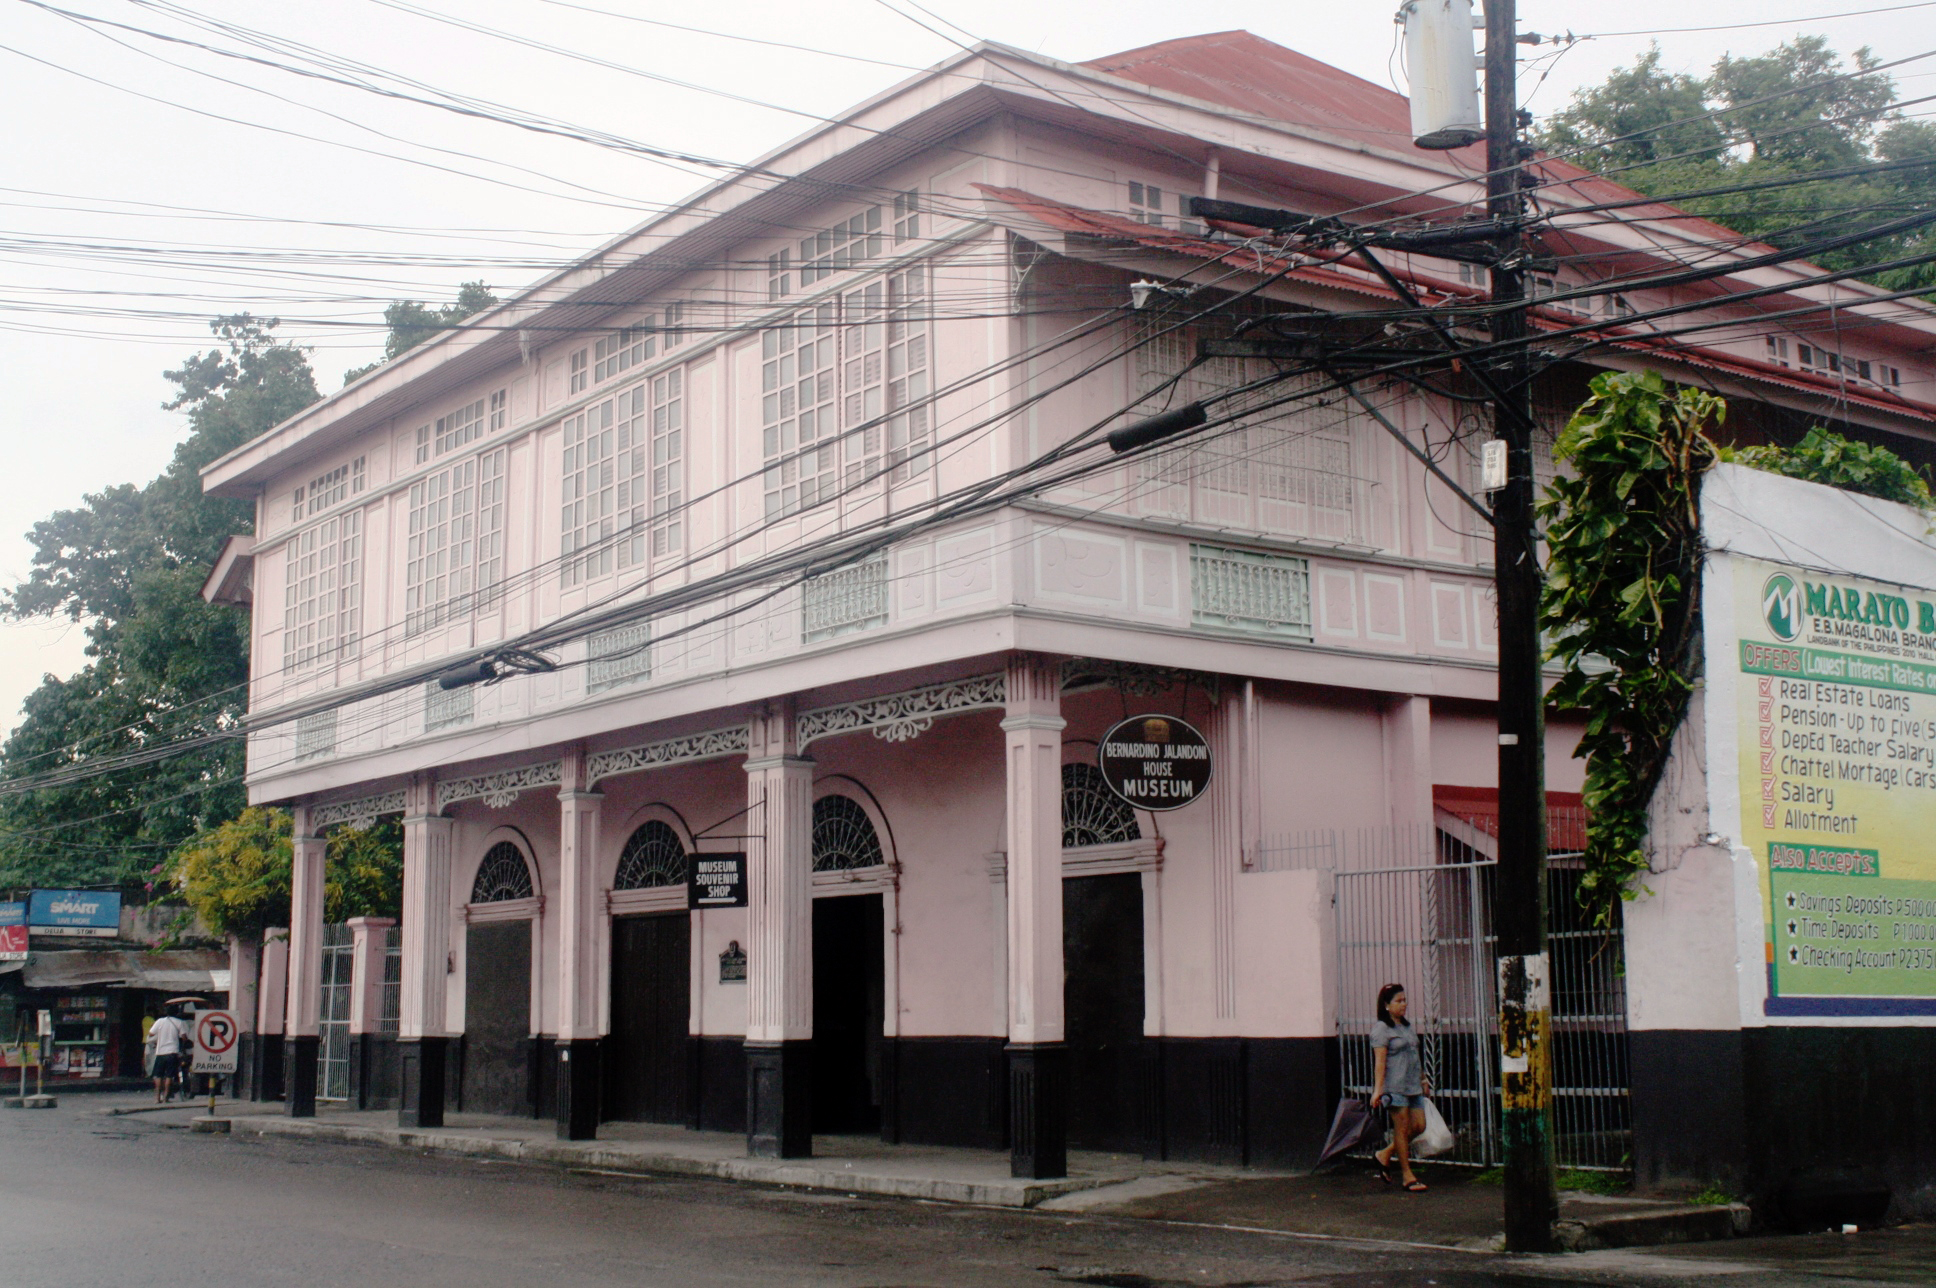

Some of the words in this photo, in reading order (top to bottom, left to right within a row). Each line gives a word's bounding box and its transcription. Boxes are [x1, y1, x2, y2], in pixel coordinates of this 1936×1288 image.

[1803, 581, 1909, 630] MARAYO
[1916, 600, 1936, 635] B
[1807, 634, 1840, 648] LANDBANK
[1841, 640, 1849, 648] OF
[1851, 640, 1862, 650] THE
[1864, 643, 1900, 656] PHILIPPINES
[1745, 643, 1800, 672] OFFERS
[1848, 656, 1890, 682] Interest
[1892, 663, 1924, 688] Rates
[1780, 680, 1811, 701] Real
[1815, 683, 1864, 707] Estate
[1869, 689, 1910, 712] Loans
[1781, 704, 1837, 728] Pension
[1847, 711, 1865, 734] Up
[1869, 714, 1885, 733] to
[1106, 742, 1160, 758] BERNARDINO
[1163, 744, 1207, 760] JALANDONI
[1782, 730, 1824, 753] DepEd
[1829, 734, 1881, 757] Teacher
[1886, 739, 1934, 769] Salary
[1143, 761, 1173, 777] HOUSE
[1781, 755, 1834, 779] Chattel
[1123, 779, 1193, 798] MUSEUM
[1781, 781, 1834, 811] Salary
[1784, 808, 1858, 834] Allotment
[698, 861, 737, 874] MUSEUM
[1771, 845, 1804, 869] Also
[1807, 848, 1876, 875] Accepts:
[696, 873, 738, 886] SOUVENIR
[708, 885, 731, 897] SHOP
[50, 902, 99, 914] SMART
[1800, 892, 1842, 918] Savings
[1845, 894, 1893, 917] Deposits
[1801, 917, 1827, 938] Time
[1831, 919, 1879, 945] Deposits
[1801, 945, 1853, 974] Checking
[1855, 948, 1897, 968] Account
[195, 1062, 234, 1071] PARKING
[208, 1054, 222, 1063] NO
